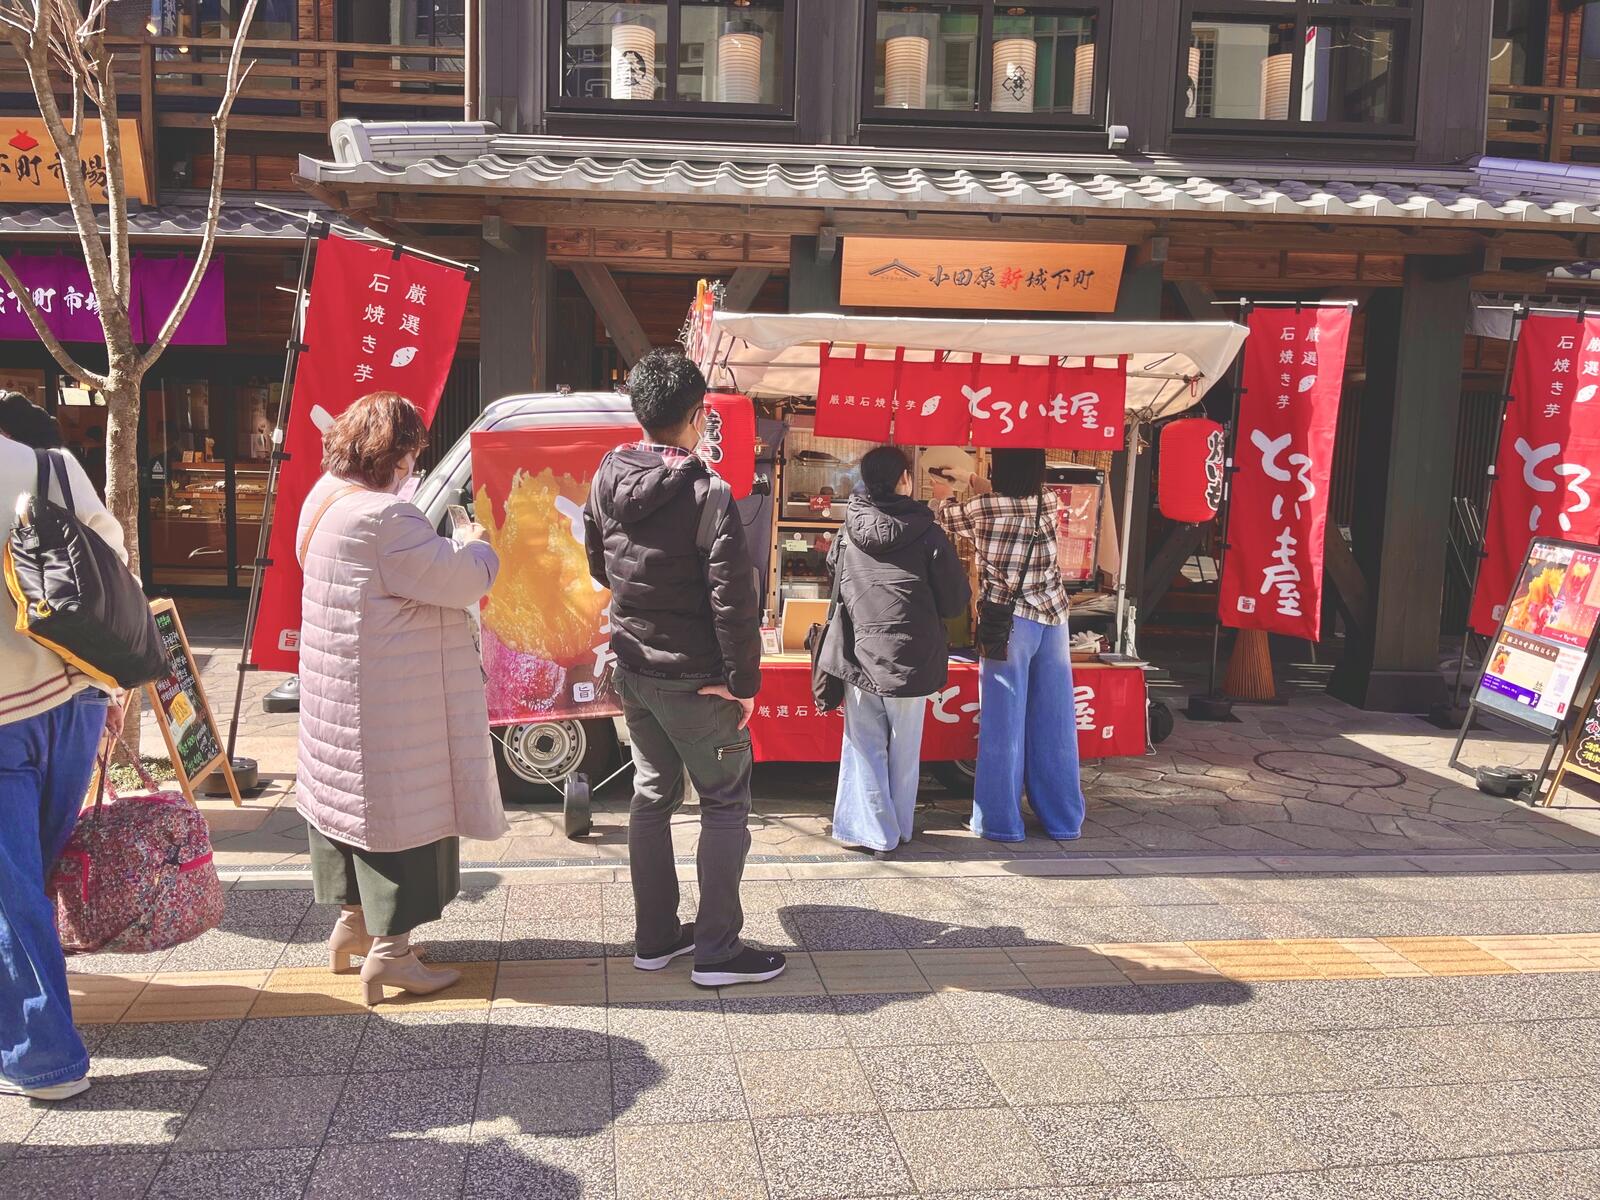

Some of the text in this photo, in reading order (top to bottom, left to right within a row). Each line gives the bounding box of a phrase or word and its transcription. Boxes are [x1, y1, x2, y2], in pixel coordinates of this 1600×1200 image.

[929, 265, 1095, 291] 小田原新城下町
[353, 273, 391, 382] 石焼き芋
[399, 283, 428, 336] 厳選
[1276, 327, 1296, 409] 石焼き芋
[1301, 327, 1320, 366] 厳選
[1543, 335, 1575, 418] 石焼き芋
[829, 384, 1099, 434] 厳選石焼き芋 とろいも屋
